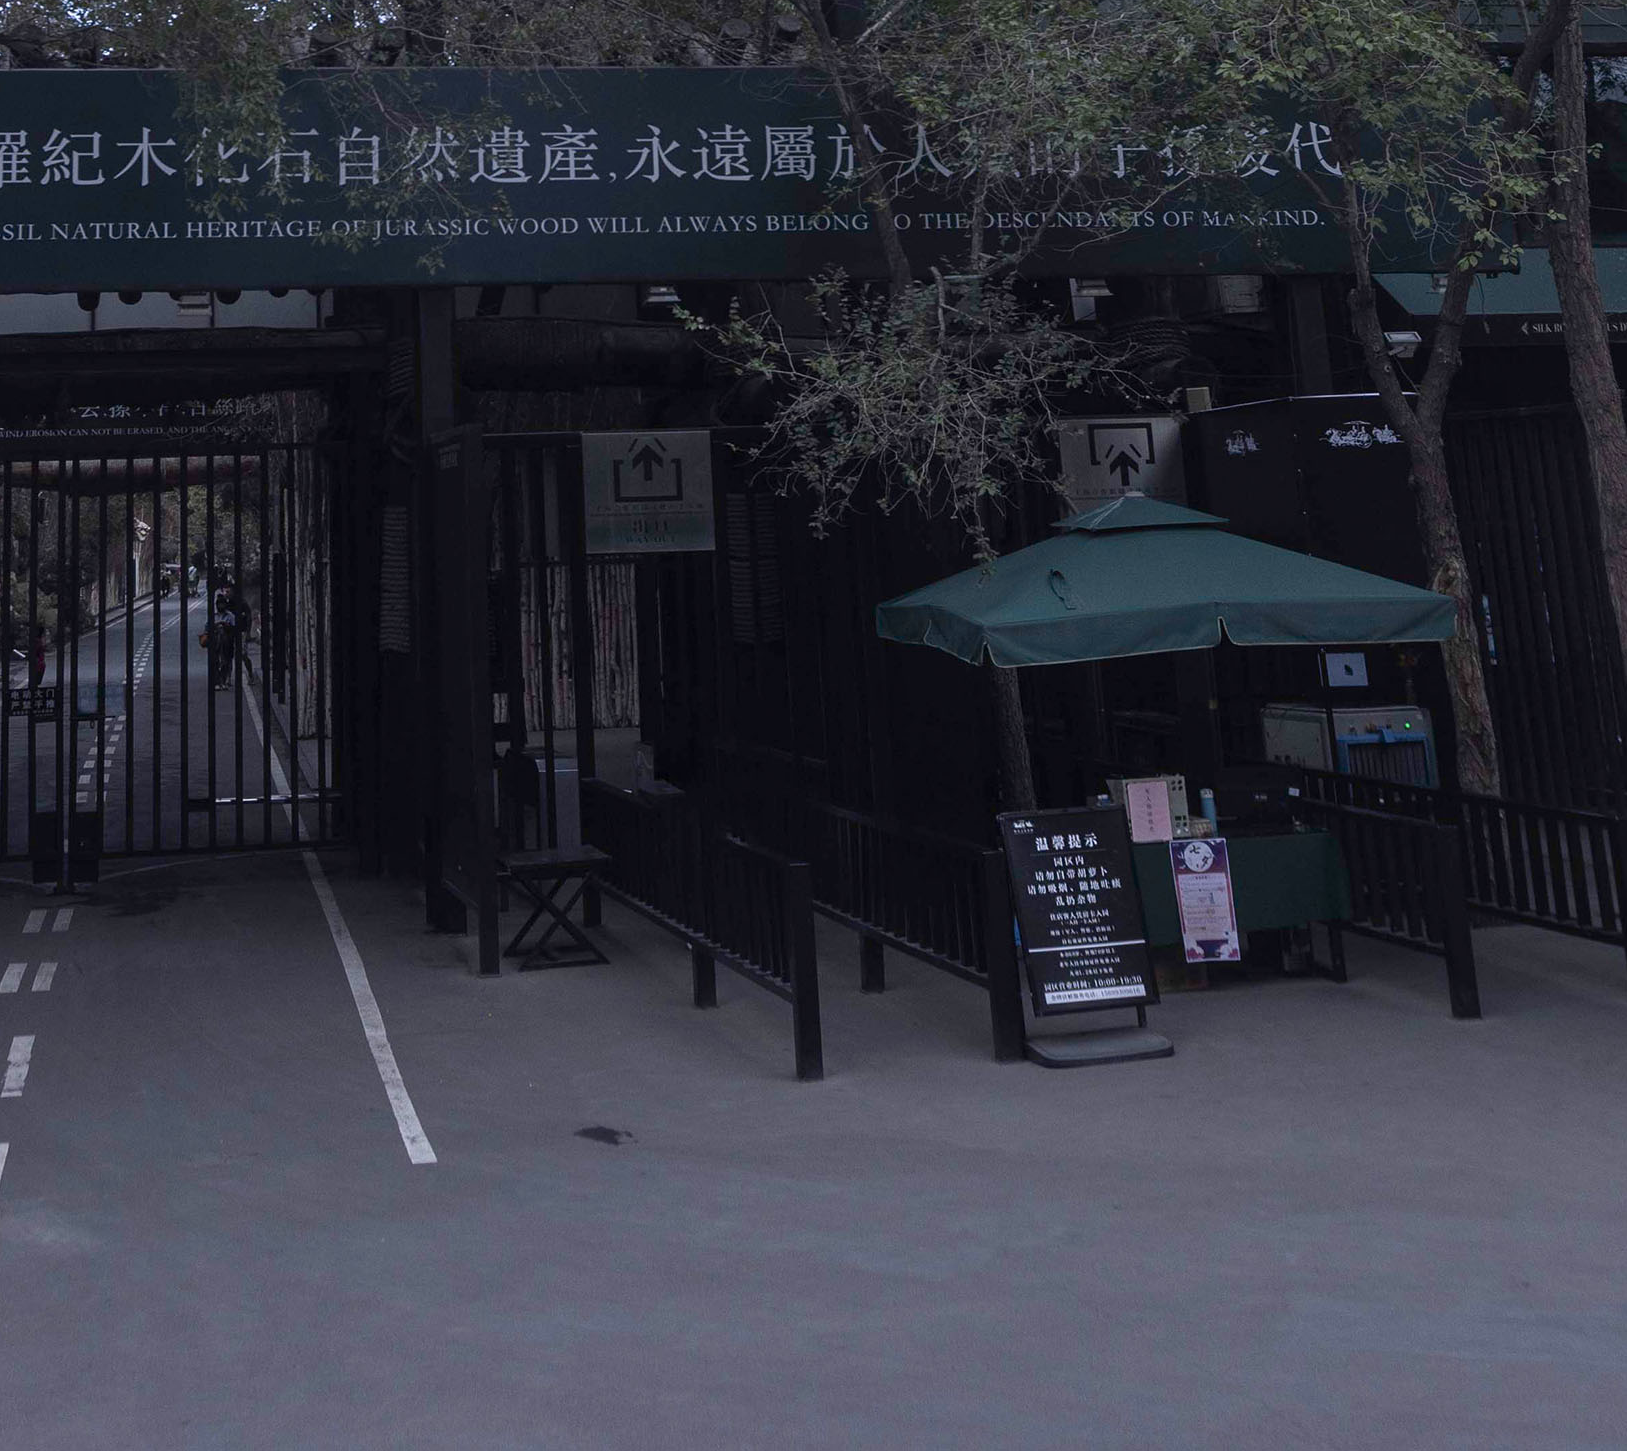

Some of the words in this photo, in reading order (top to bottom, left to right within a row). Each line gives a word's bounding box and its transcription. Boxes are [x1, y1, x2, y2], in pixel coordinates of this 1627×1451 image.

[50, 222, 177, 240] NATURAL
[185, 220, 323, 238] HERITAGE
[331, 219, 367, 237] OF
[372, 218, 490, 240] JURASSIC
[497, 217, 579, 235] WOOD
[587, 216, 650, 234] WILL
[655, 214, 758, 233] ALWAYS
[765, 213, 869, 232] BELONG
[919, 212, 972, 230] THE
[1162, 210, 1194, 228] OF
[1034, 832, 1099, 853] 温馨提示
